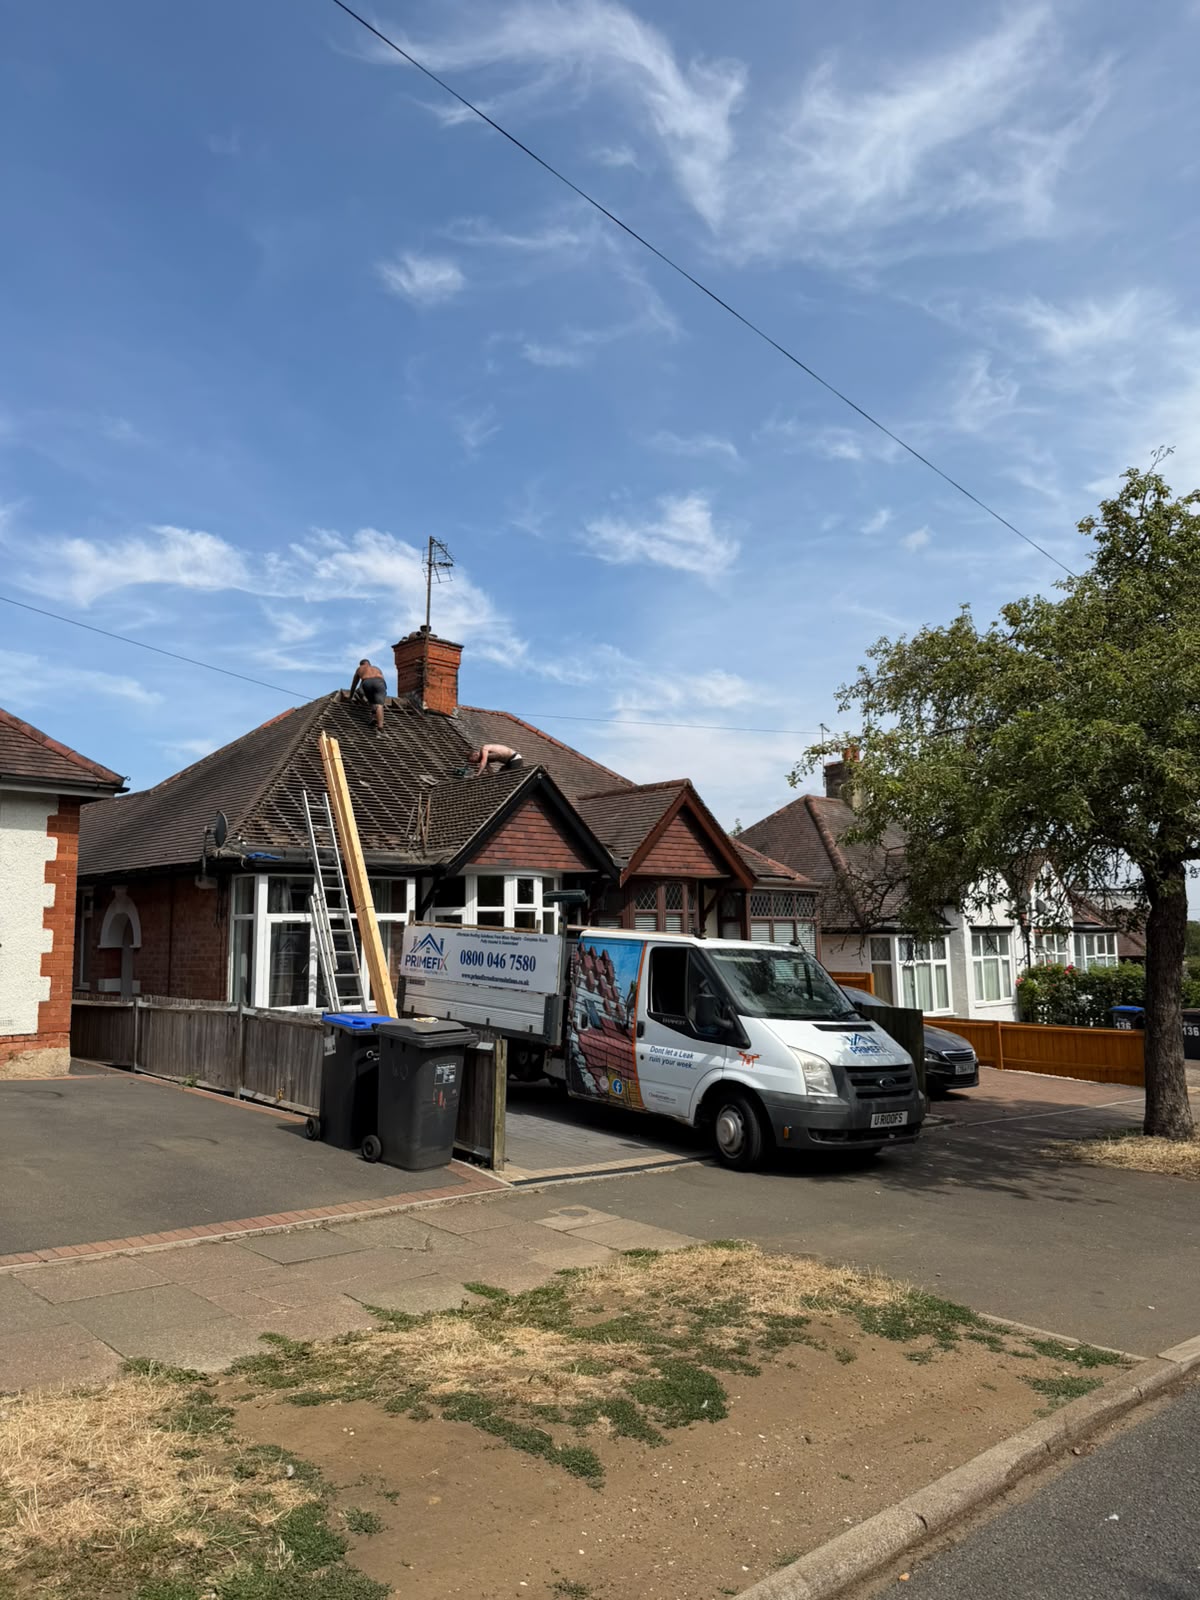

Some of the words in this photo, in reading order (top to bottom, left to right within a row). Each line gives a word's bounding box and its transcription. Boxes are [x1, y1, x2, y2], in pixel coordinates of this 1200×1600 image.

[405, 951, 449, 971] PRIMEFIX
[460, 949, 484, 967] 0800
[487, 951, 507, 970] 046
[509, 953, 536, 973] 7580
[1116, 1021, 1132, 1030] 136
[1183, 1026, 1200, 1037] 136
[664, 1047, 674, 1056] let
[679, 1050, 694, 1060] Leak
[661, 1058, 676, 1066] your
